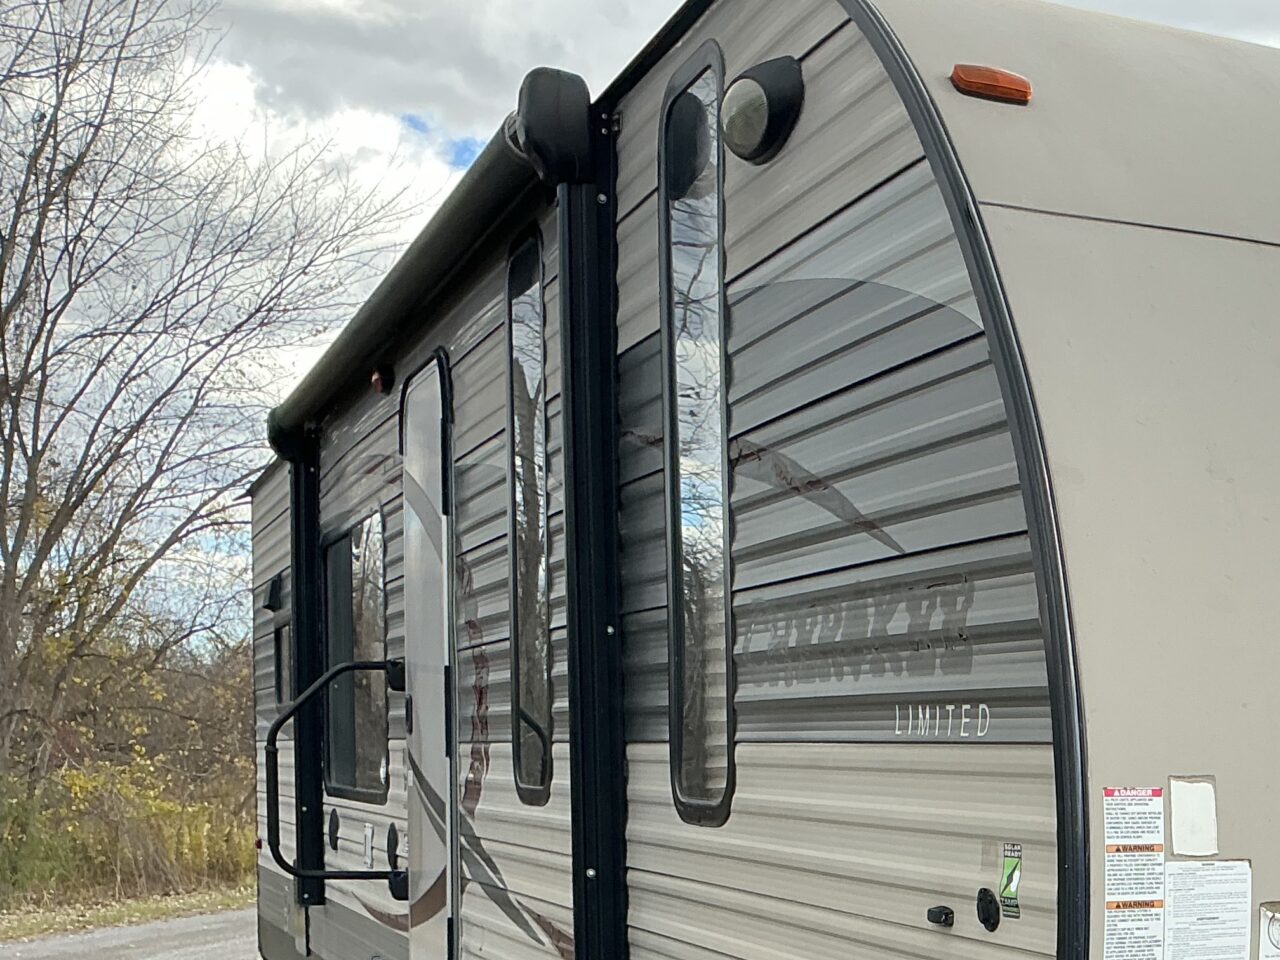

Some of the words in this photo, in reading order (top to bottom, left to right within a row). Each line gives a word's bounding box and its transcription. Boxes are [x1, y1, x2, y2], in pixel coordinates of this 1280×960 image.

[894, 703, 991, 737] LIMITED
[1120, 789, 1153, 797] DANGER
[1004, 843, 1021, 851] SOLAR
[1122, 844, 1155, 853] WARNING
[1121, 901, 1155, 909] WARNING
